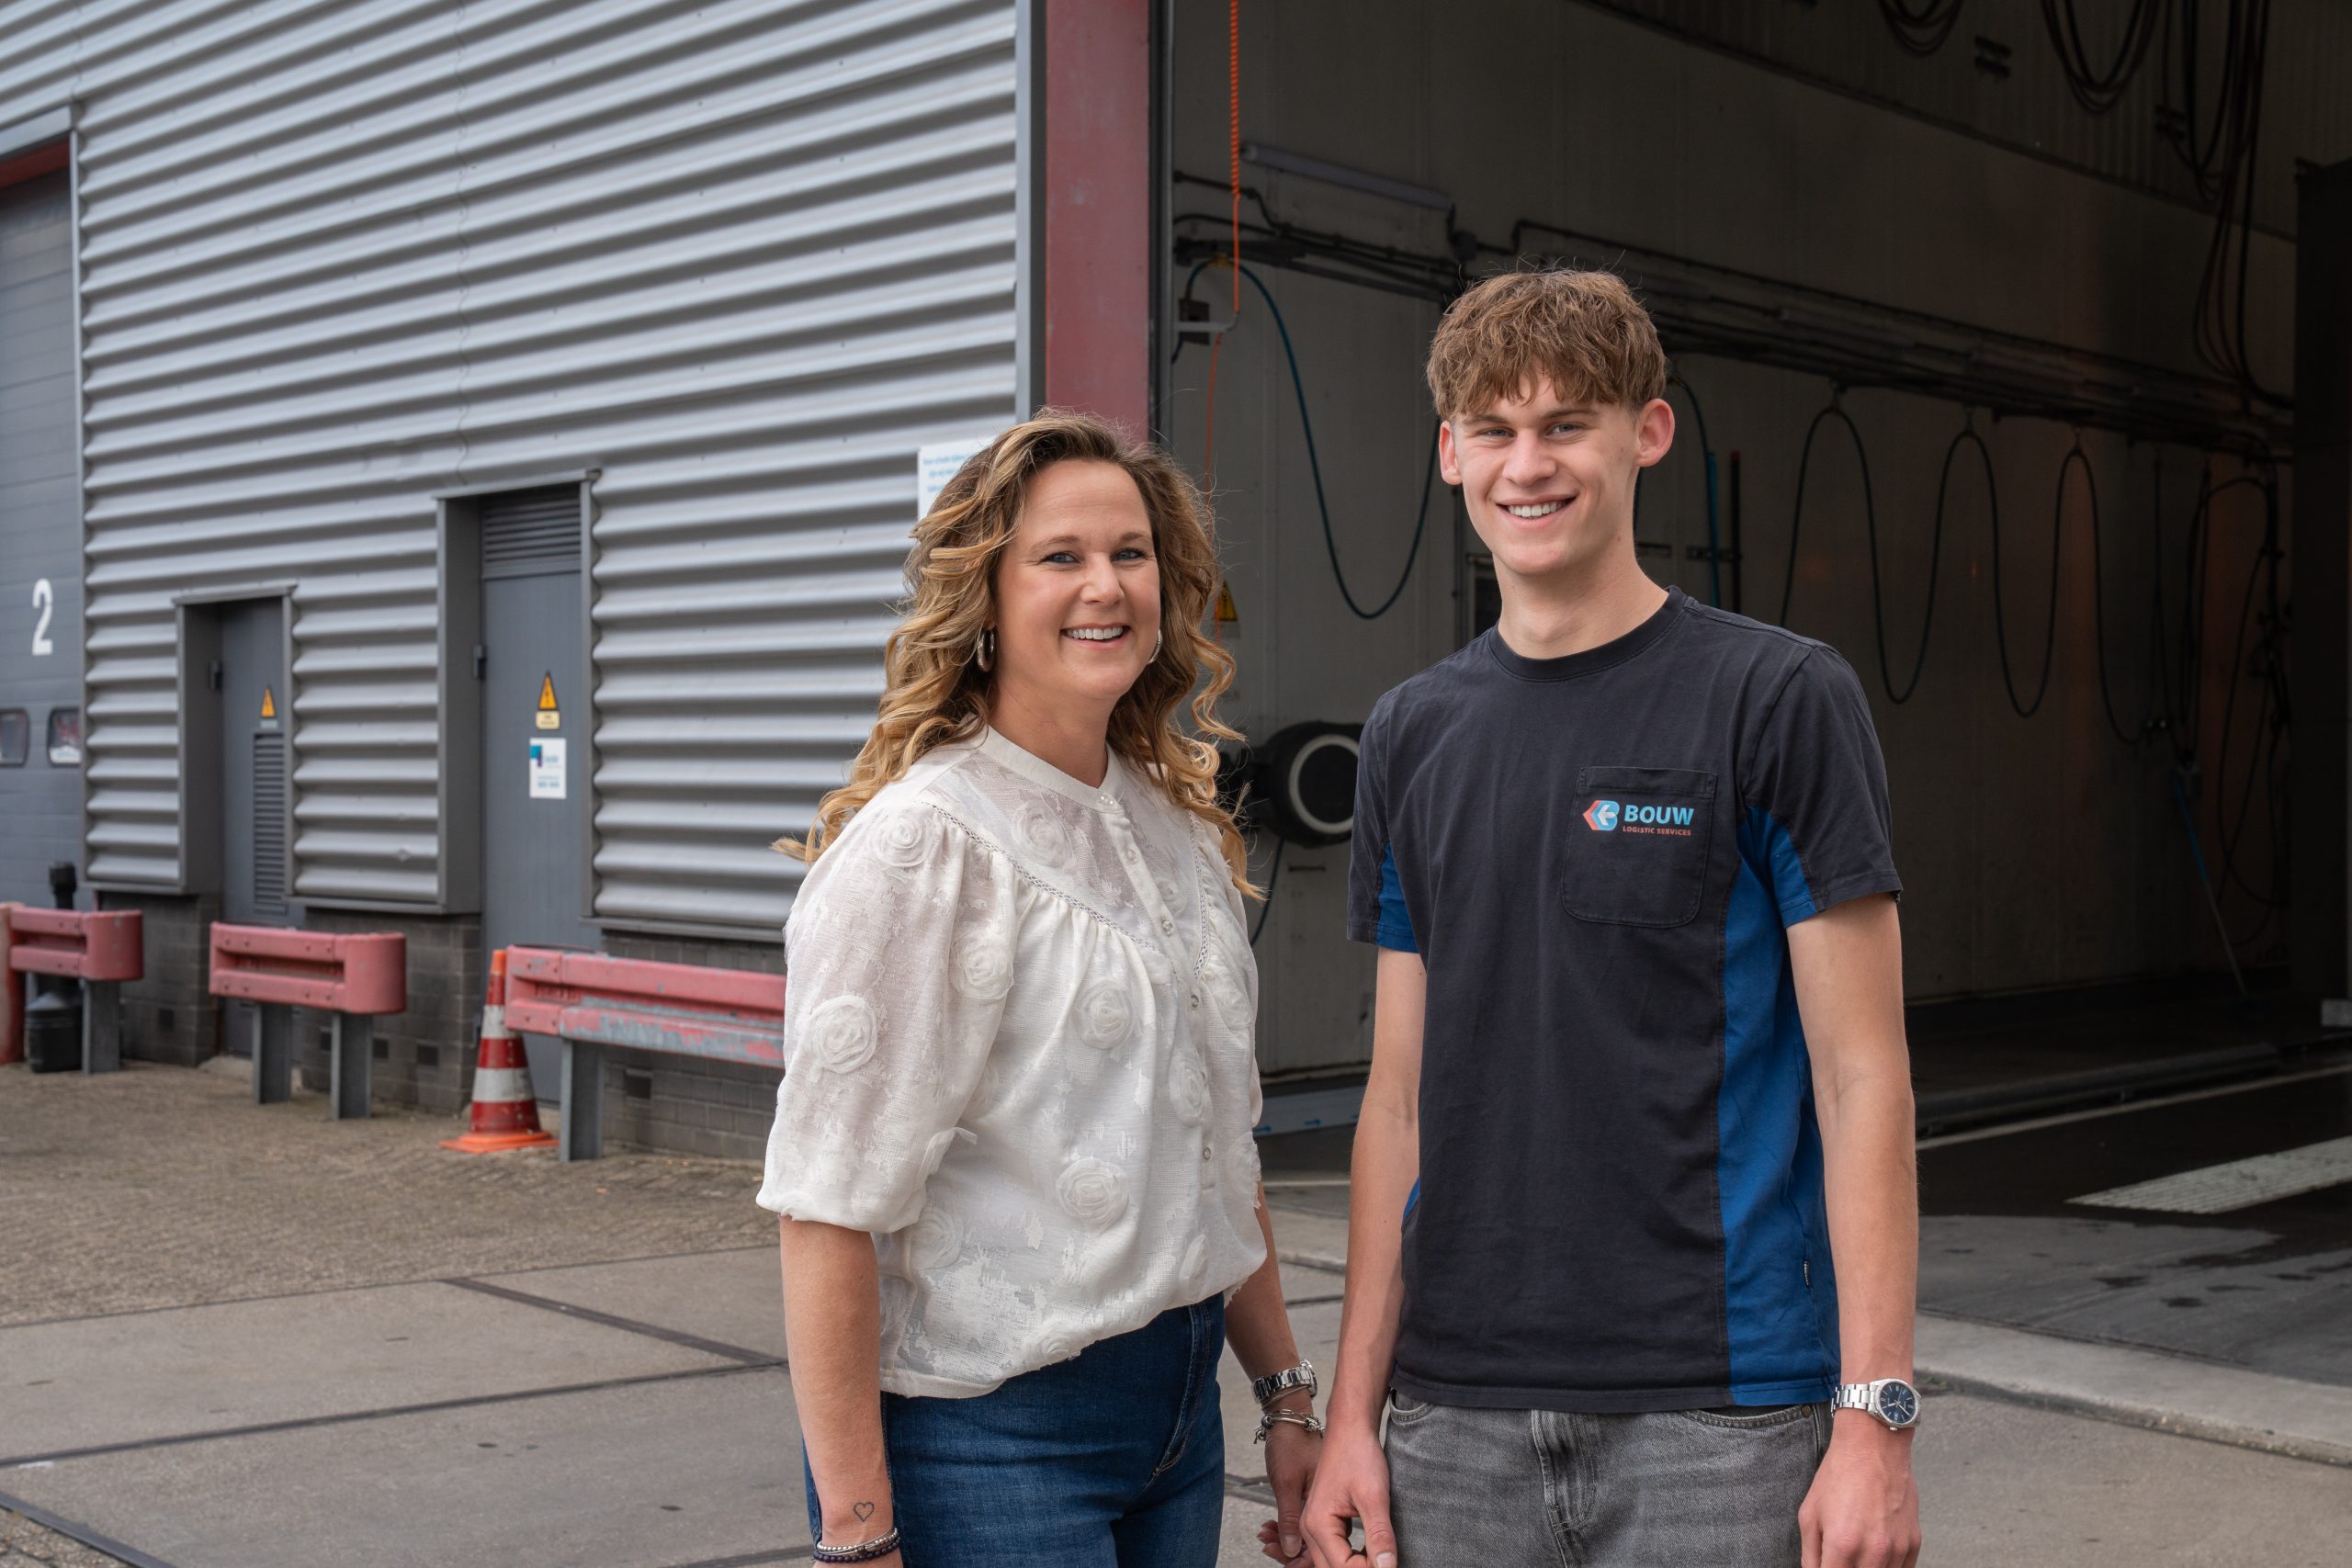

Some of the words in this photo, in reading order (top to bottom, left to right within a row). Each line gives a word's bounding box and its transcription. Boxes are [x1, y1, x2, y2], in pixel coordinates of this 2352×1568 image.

[32, 578, 53, 656] 2
[1624, 805, 1694, 825] BOUW
[1623, 826, 1655, 834] LOGISTIC
[1657, 828, 1691, 836] SERVICES
